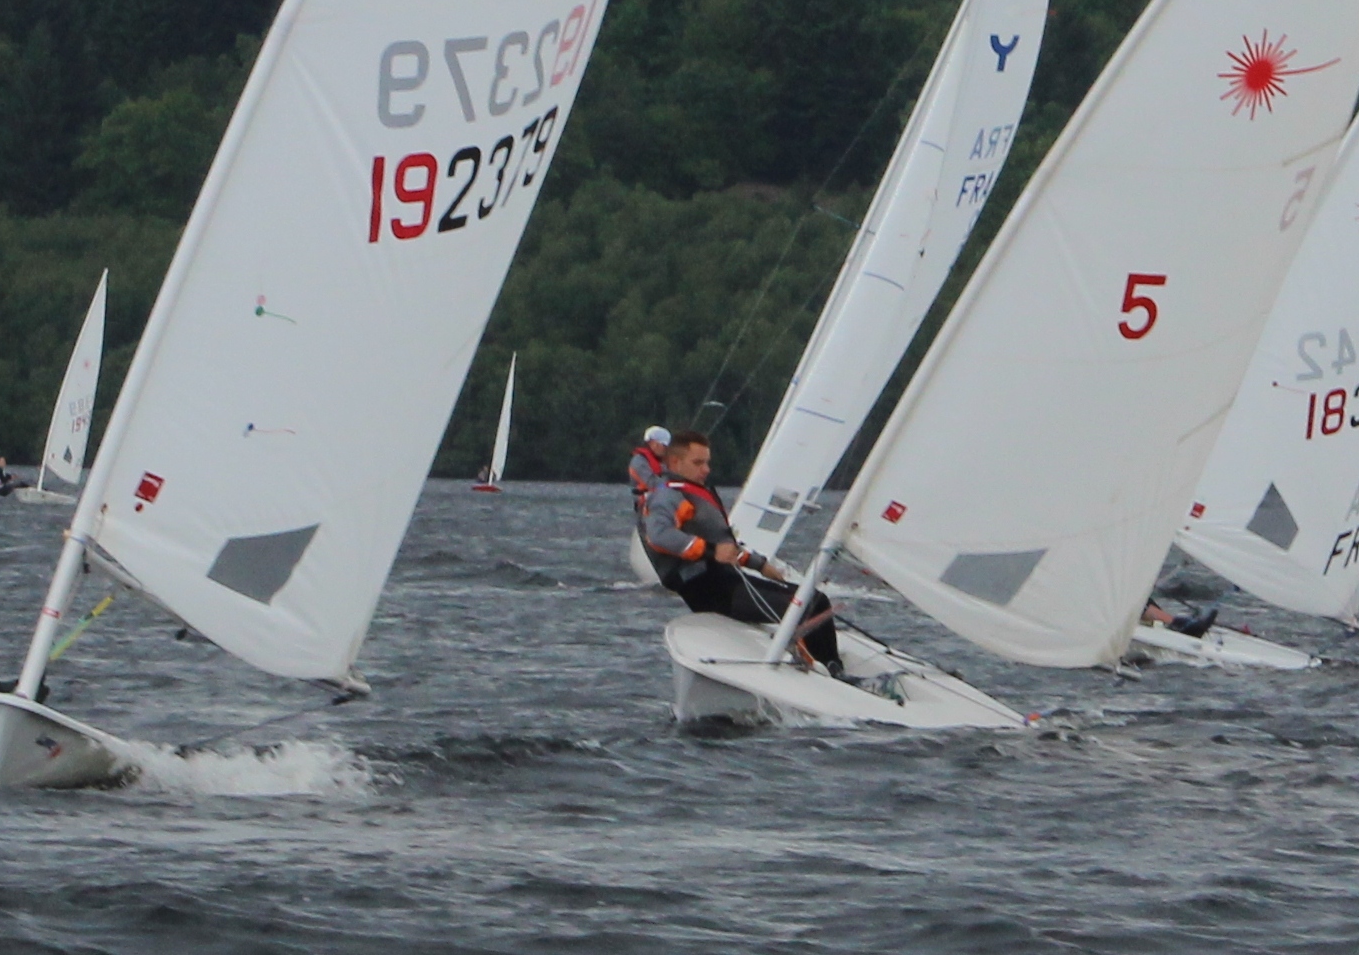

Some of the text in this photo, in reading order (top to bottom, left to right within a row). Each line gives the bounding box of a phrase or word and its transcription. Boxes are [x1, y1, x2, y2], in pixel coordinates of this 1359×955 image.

[990, 34, 1020, 72] Y
[368, 105, 558, 244] 192379
[1117, 273, 1167, 340] 5
